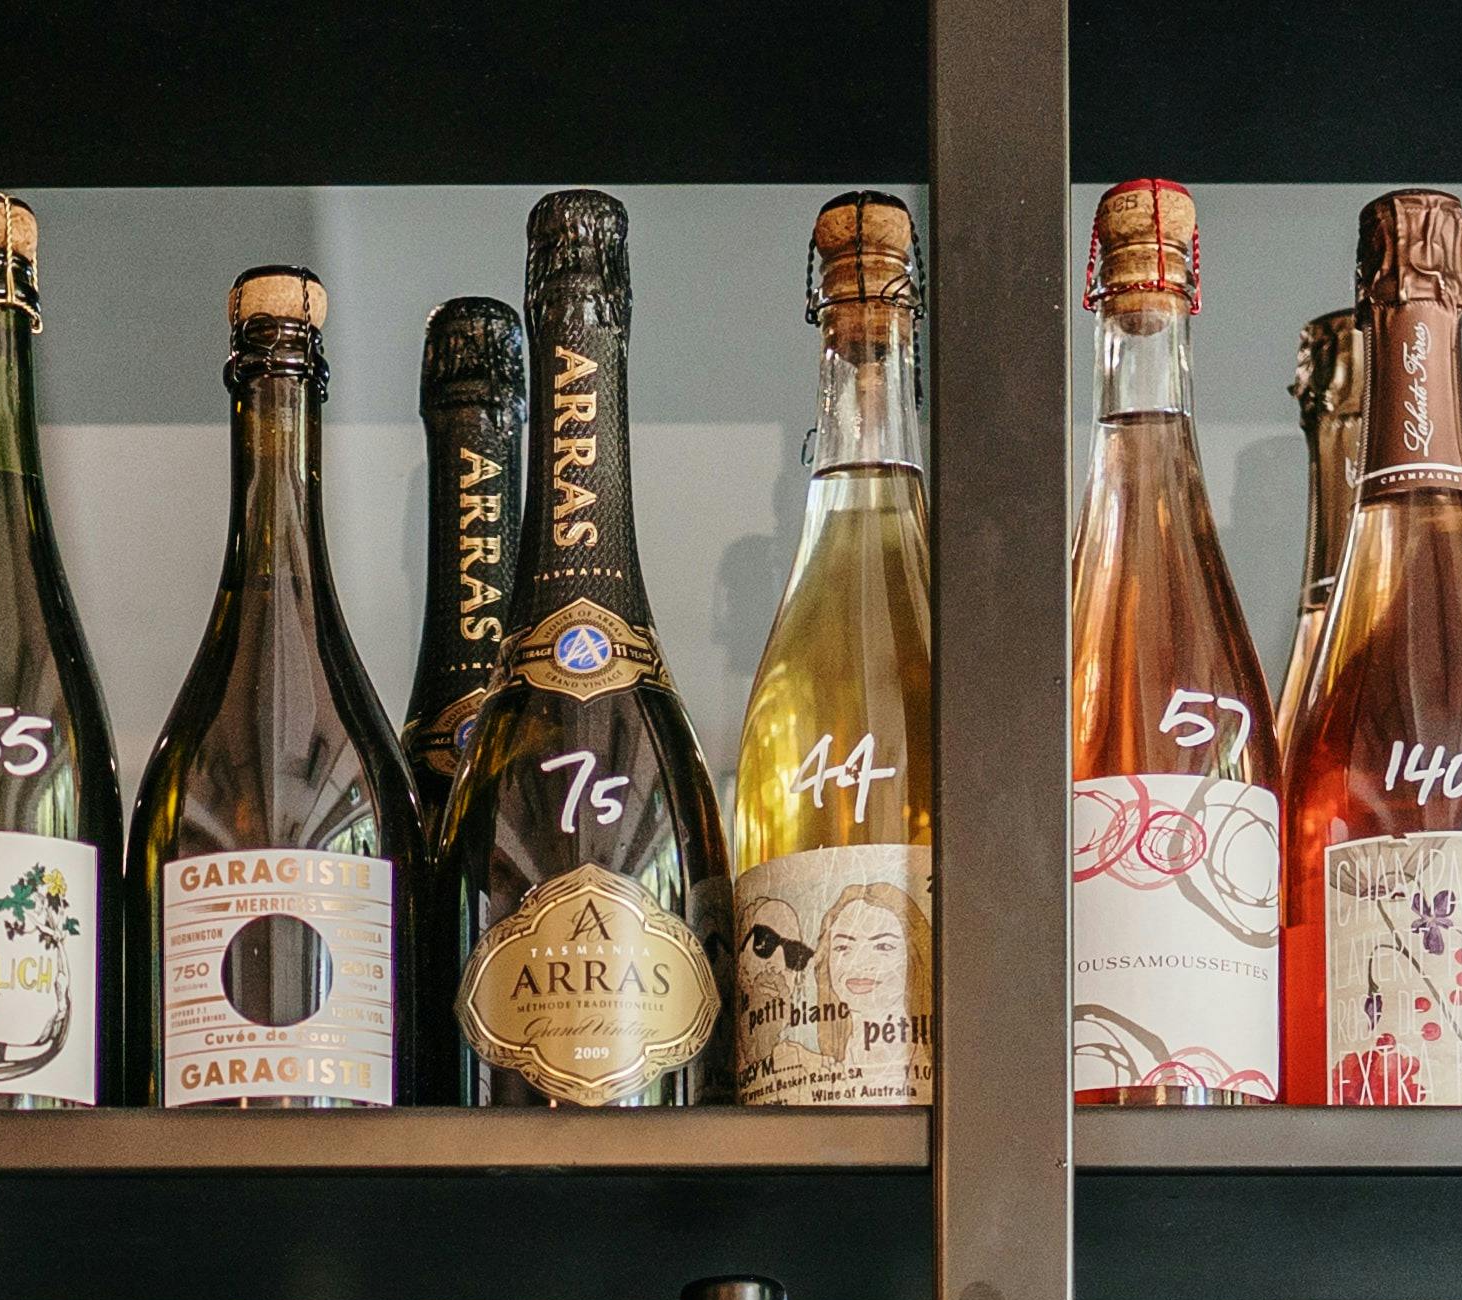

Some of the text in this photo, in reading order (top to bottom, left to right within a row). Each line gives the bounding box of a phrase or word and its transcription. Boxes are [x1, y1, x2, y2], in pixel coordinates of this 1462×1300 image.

[553, 346, 598, 548] ARRAS
[1380, 470, 1461, 487] CHAMPAGNE
[459, 447, 503, 642] ARRAS
[1158, 687, 1252, 766] 57
[541, 749, 630, 835] 75
[790, 732, 896, 824] 44
[179, 857, 372, 893] GARAGISTE
[235, 894, 318, 913] MERRICKS
[529, 944, 652, 959] TASMANIA
[172, 962, 210, 981] 750
[510, 960, 672, 1000] ARRAS
[748, 1000, 851, 1034] petit blanc
[573, 1046, 610, 1061] 2009
[180, 1057, 373, 1091] GARAGISTE
